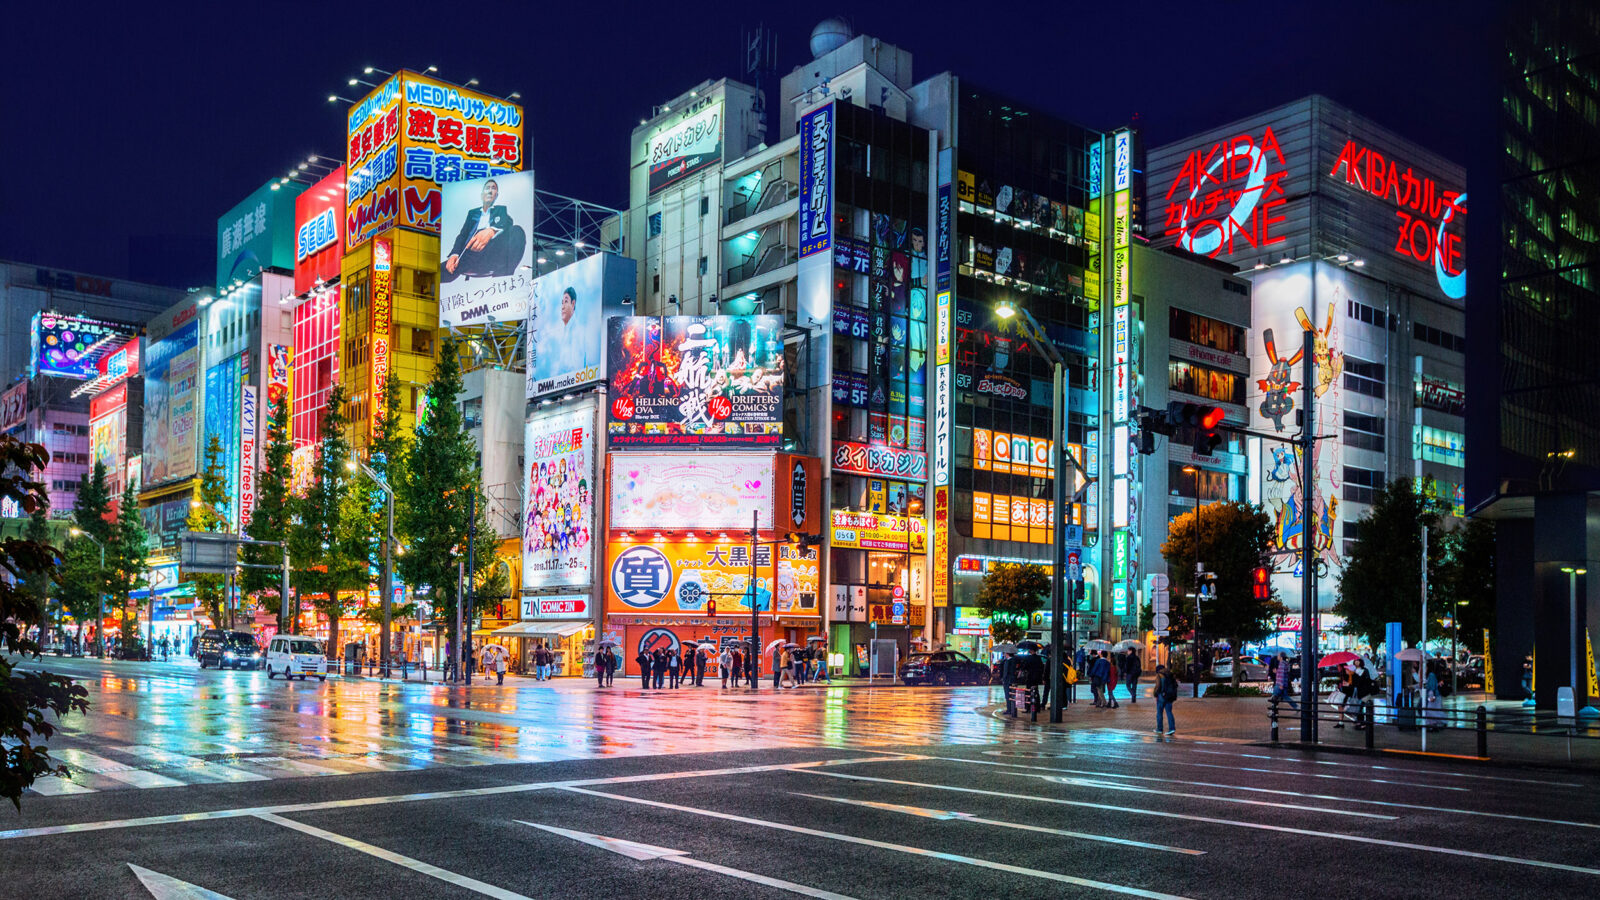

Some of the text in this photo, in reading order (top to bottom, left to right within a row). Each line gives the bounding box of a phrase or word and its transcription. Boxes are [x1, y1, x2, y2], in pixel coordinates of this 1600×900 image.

[404, 81, 521, 128] MEDIAリサイクル
[349, 104, 400, 168] 激安販売
[405, 108, 520, 165] 激安販売
[653, 114, 718, 163] メイドカジノ
[403, 148, 519, 185] 高額買
[1165, 126, 1287, 201] AKIBA
[1330, 140, 1468, 224] AKIBAカルチ
[1165, 171, 1288, 227] カルチャーズ
[347, 186, 399, 248] Mulan
[297, 206, 340, 265] SEGA
[1116, 215, 1125, 247] Yellow
[1394, 211, 1461, 276] ZONE
[854, 256, 870, 273] 7F
[461, 302, 509, 323] DMM.com
[957, 310, 972, 325] 5F
[852, 321, 869, 338] 6F
[538, 368, 600, 397] DMM.make solar
[957, 373, 972, 388] 5F
[243, 387, 256, 427] AKKY
[636, 398, 680, 407] HELLSING
[712, 398, 731, 417] 11/30
[731, 404, 775, 412] COMICS 6
[732, 396, 780, 405] DRIFTERS
[851, 389, 868, 406] 5F
[635, 406, 654, 415] OVA
[834, 445, 926, 476] メイドカジノ
[240, 493, 254, 526] Shop
[836, 531, 856, 540] りらくる
[676, 559, 705, 571] チケット
[706, 546, 773, 571] 大黒屋
[619, 556, 665, 601] 質
[523, 598, 540, 618] ZIN
[541, 600, 575, 613] COMIC ZIN
[835, 605, 865, 614] ルノアール
[712, 626, 748, 635] チケット
